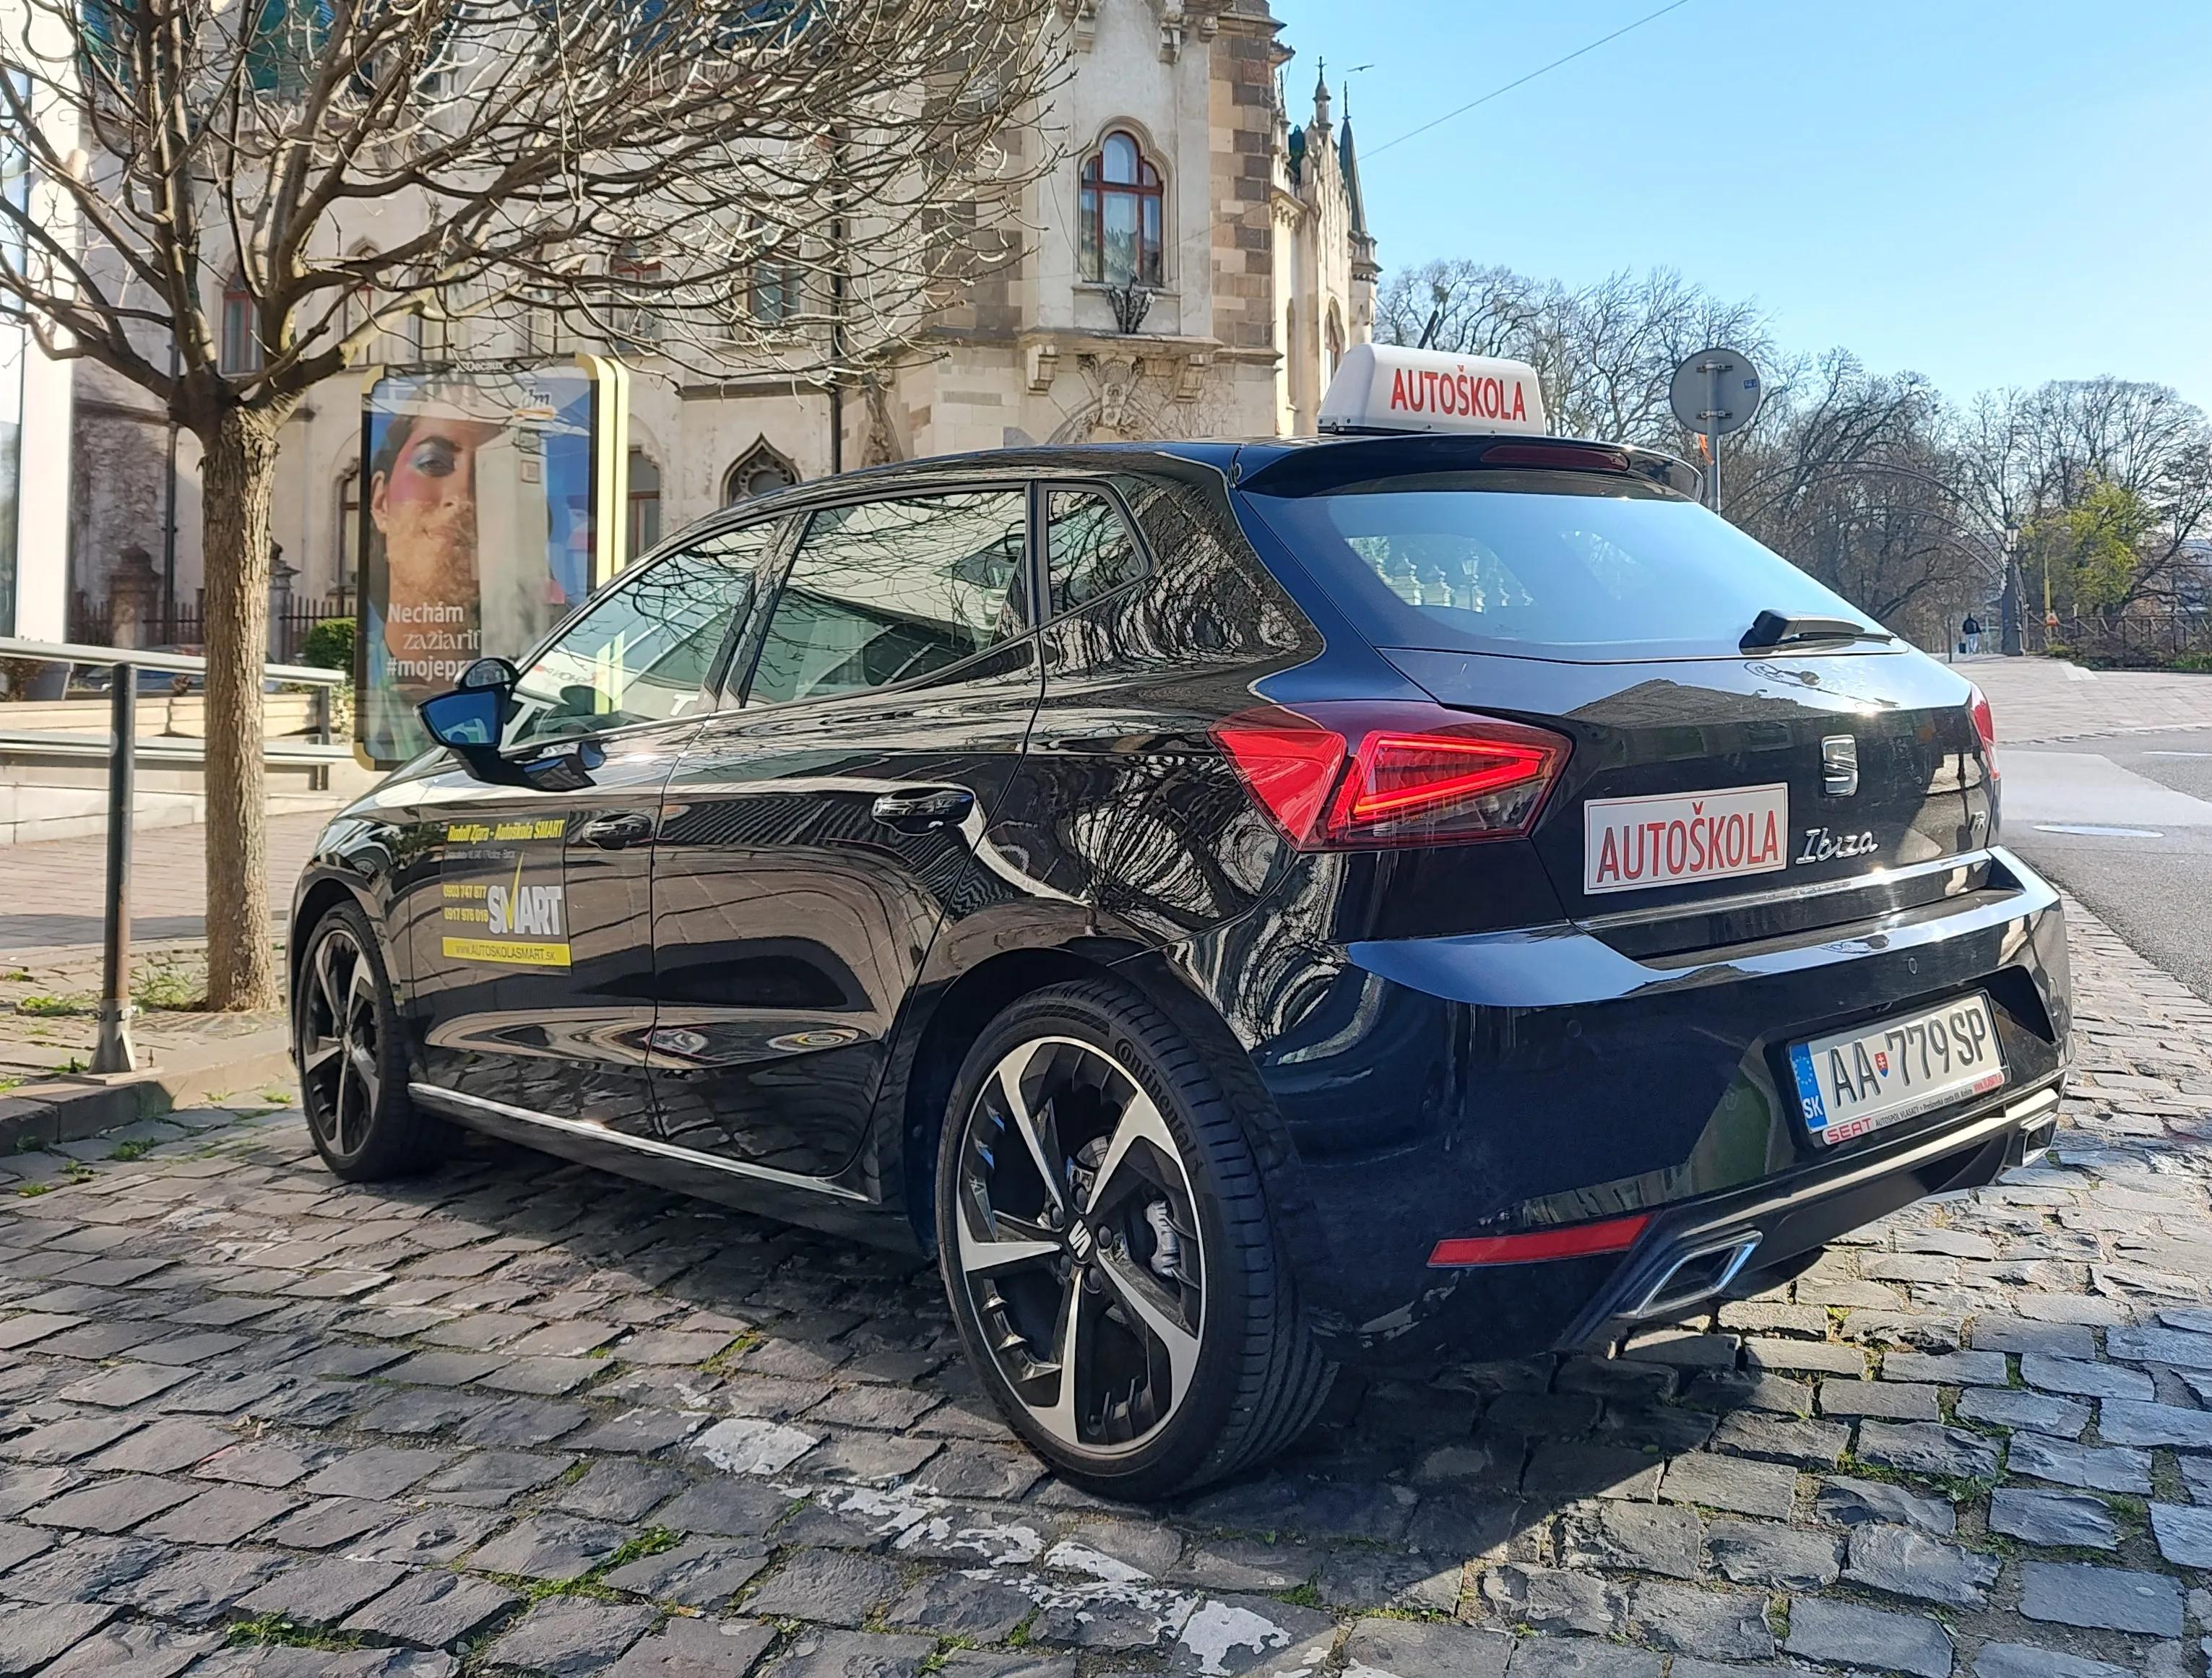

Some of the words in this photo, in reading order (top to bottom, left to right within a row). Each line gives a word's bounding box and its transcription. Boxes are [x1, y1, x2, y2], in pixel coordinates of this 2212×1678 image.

[1391, 365, 1526, 422] AUTOŠKOLA
[388, 601, 464, 623] Nechám
[386, 655, 472, 681] #mojepr
[533, 820, 566, 839] SMART
[1596, 801, 1779, 883] AUTOŠKOLA
[1794, 829, 1879, 865] Ibiza
[488, 885, 562, 935] SMART
[1828, 1039, 1881, 1108] AA
[1115, 1037, 1197, 1156] Continental
[1802, 1094, 1823, 1120] SK
[1827, 1117, 1872, 1143] SEAT
